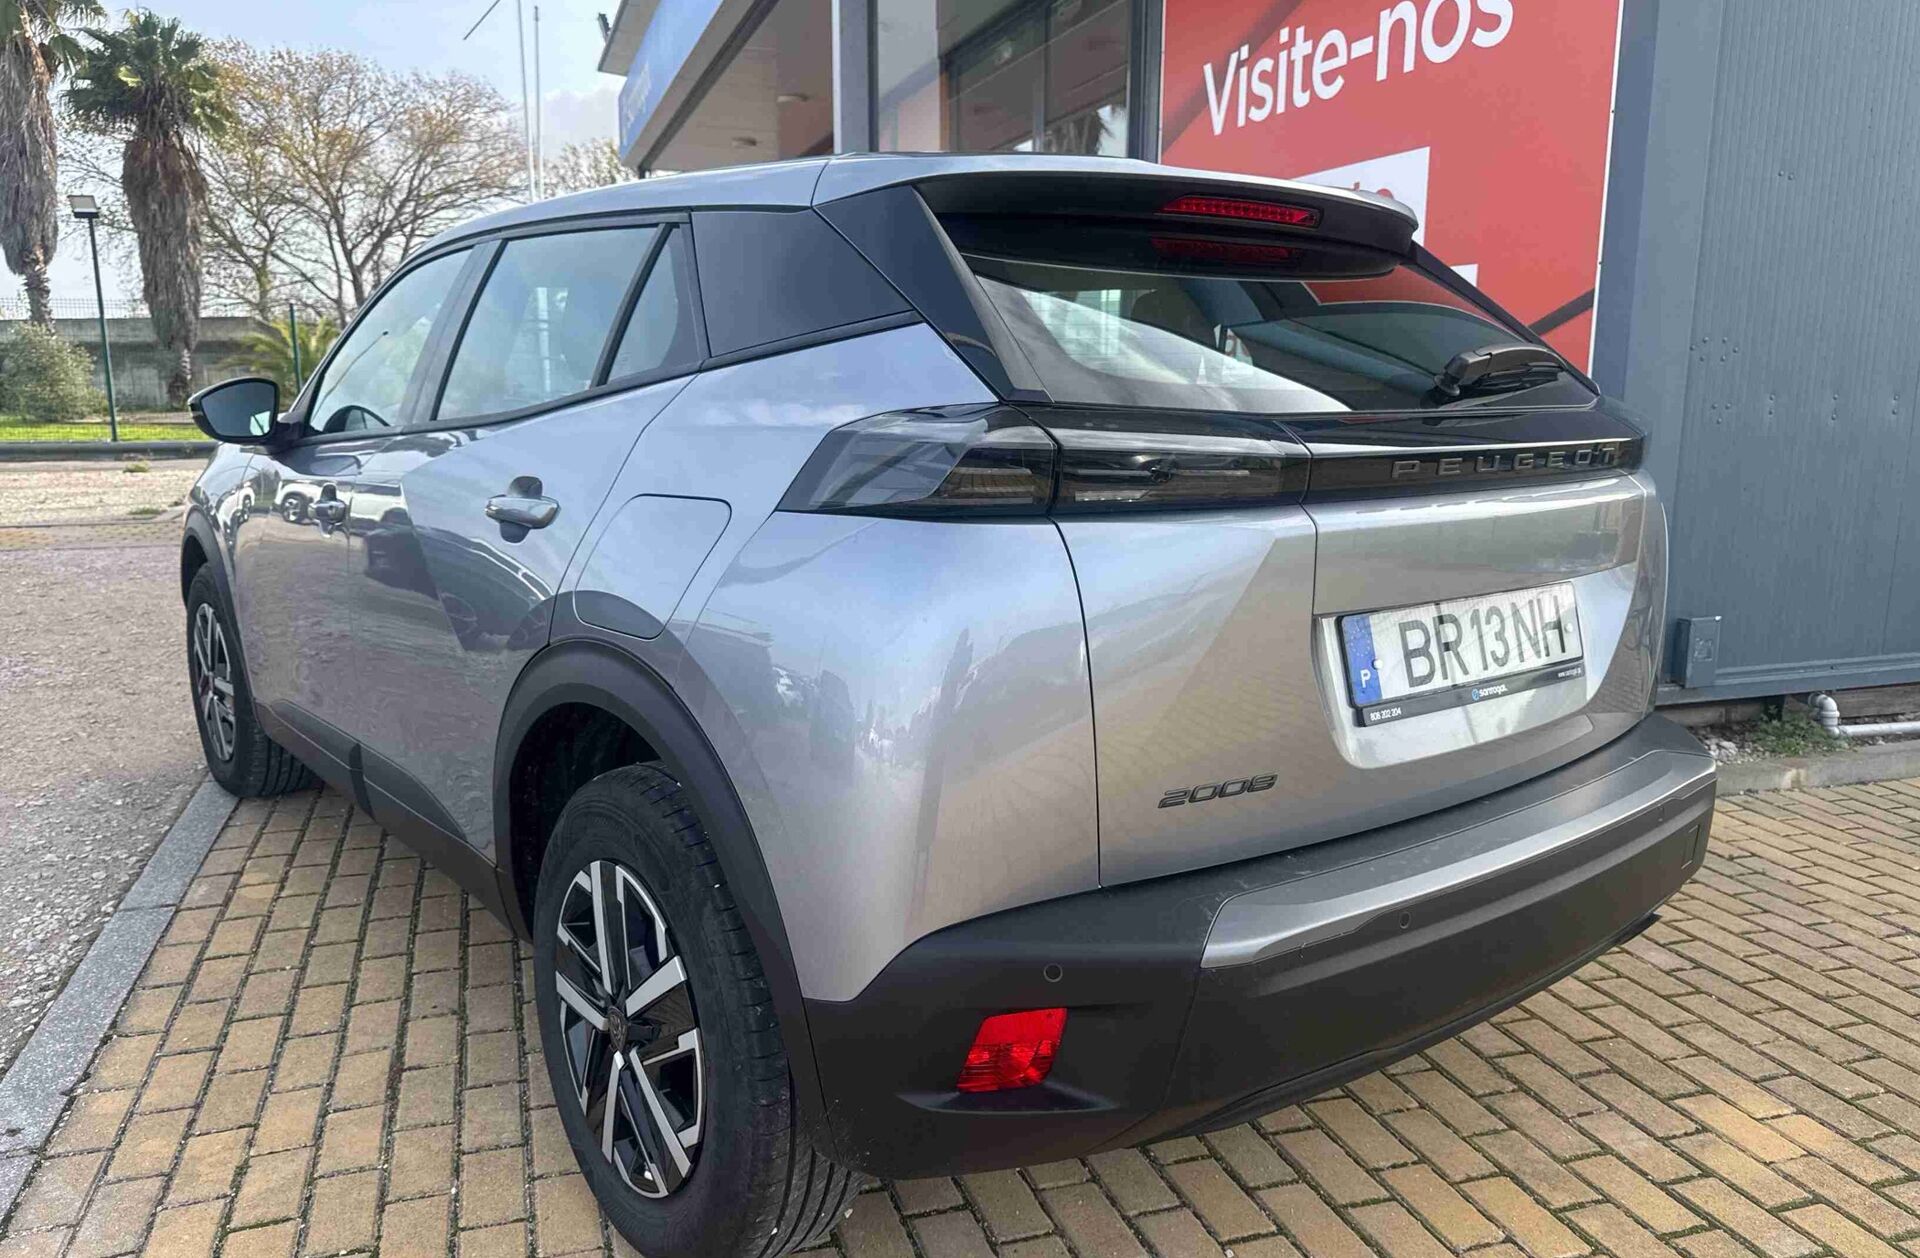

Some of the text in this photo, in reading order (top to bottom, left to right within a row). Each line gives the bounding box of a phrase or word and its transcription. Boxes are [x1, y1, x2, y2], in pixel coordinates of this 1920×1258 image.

[1203, 0, 1514, 136] Visite-nos
[1391, 446, 1617, 478] PEUGEOT
[1360, 669, 1372, 688] P
[1158, 774, 1278, 809] 2008
